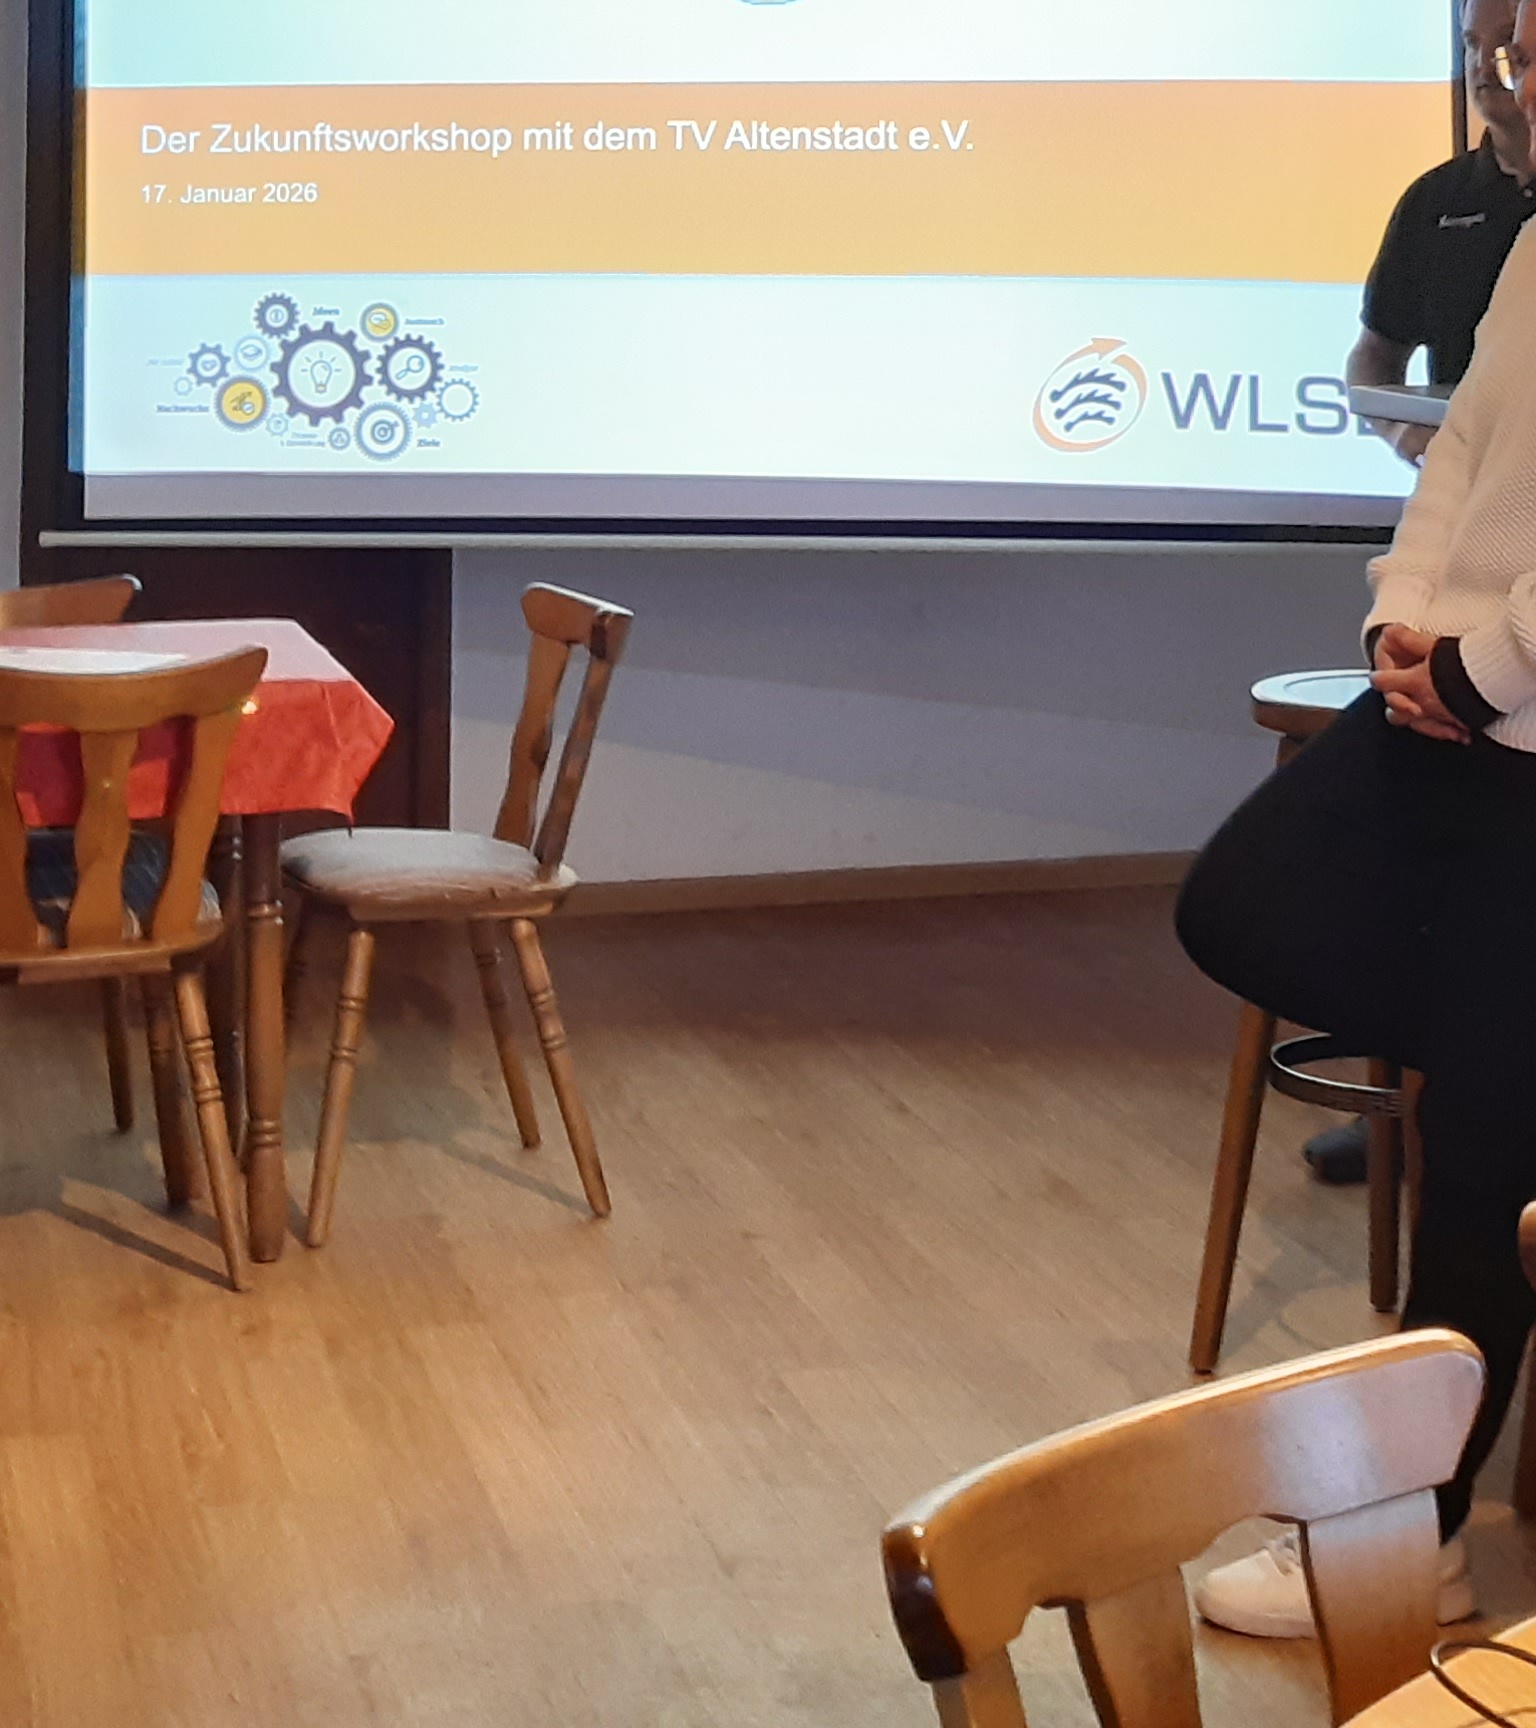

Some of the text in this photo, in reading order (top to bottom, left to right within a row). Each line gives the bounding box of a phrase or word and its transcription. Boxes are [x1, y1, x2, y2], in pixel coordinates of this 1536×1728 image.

[141, 119, 975, 158] Der Zukunftsworkshop mit dem TV Altenstadt e.V.
[141, 182, 318, 205] 17. Januar 2026
[1161, 372, 1381, 437] WLS
